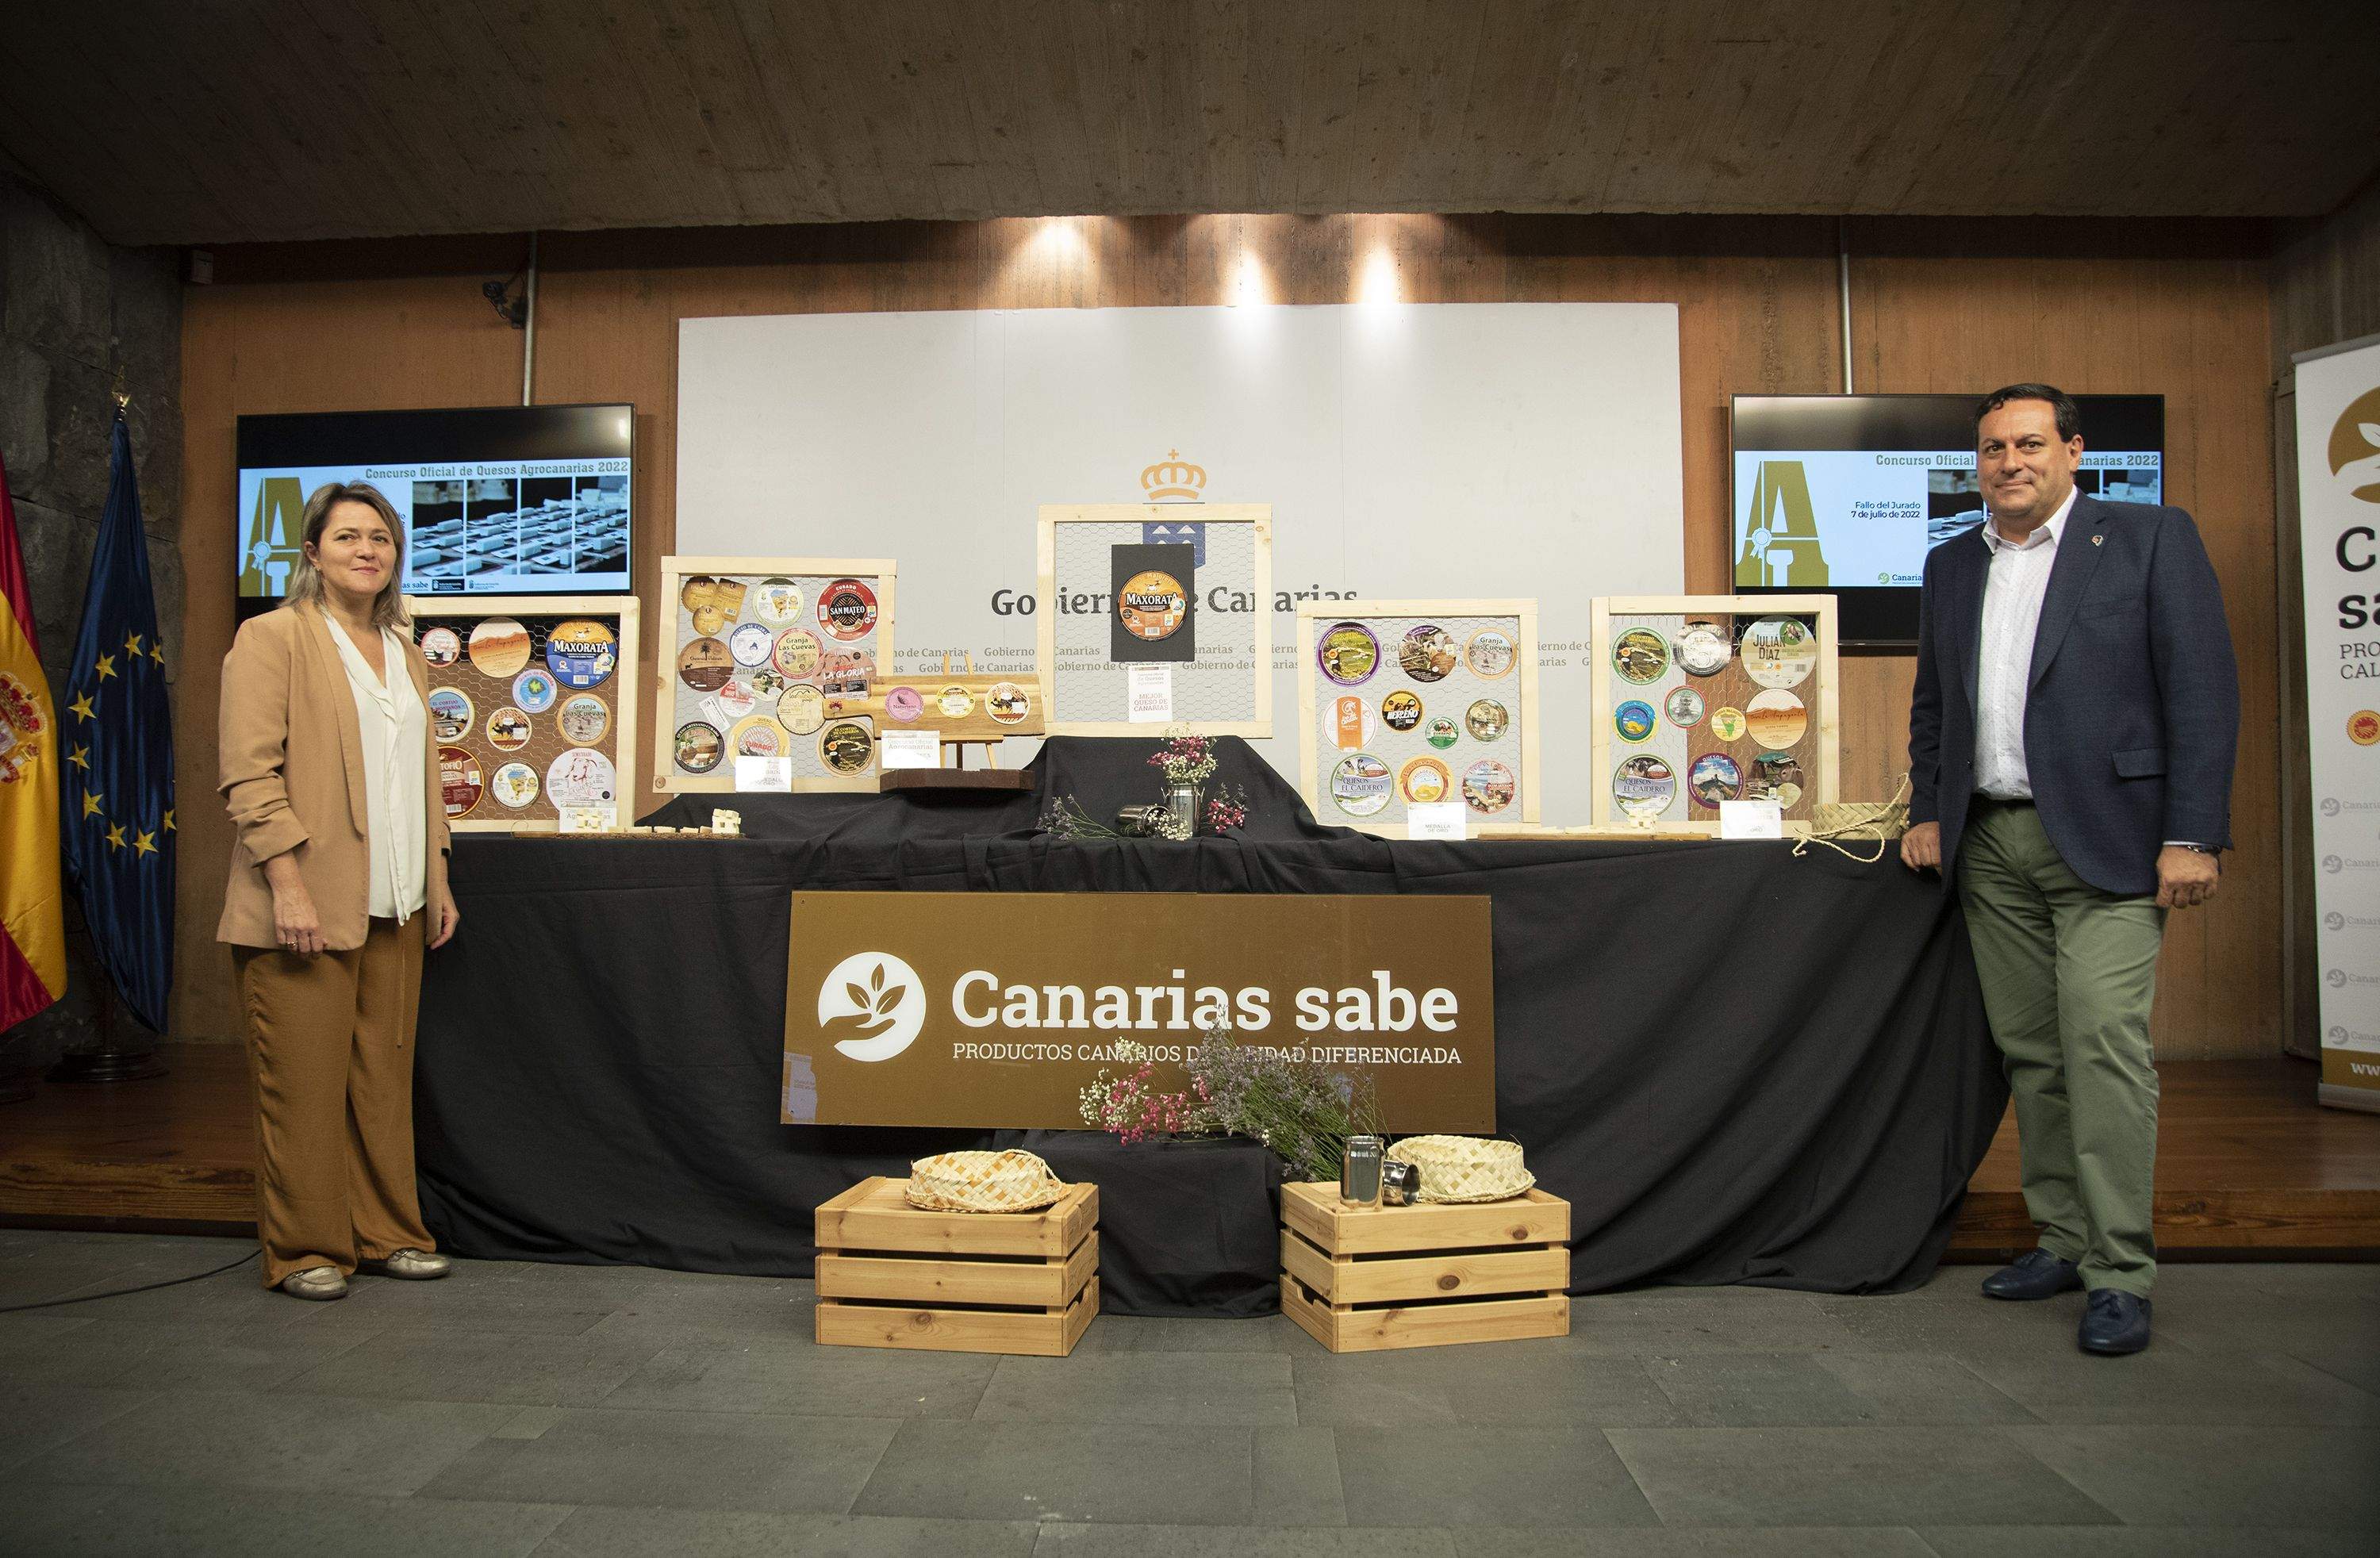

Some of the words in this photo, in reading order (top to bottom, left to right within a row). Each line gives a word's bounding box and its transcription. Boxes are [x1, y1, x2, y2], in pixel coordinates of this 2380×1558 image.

[1876, 455, 1931, 466] Concurso
[1936, 455, 1975, 466] Oficial
[2127, 455, 2158, 466] 2022
[365, 468, 416, 479] Concurso
[420, 466, 455, 477] Oficial
[459, 466, 473, 476] de
[477, 465, 516, 475] Quesos
[520, 462, 594, 476] Agrocanarias
[598, 462, 628, 472] 2022
[1870, 510, 1887, 520] julio
[830, 607, 843, 616] SAN
[554, 640, 609, 653] MAXORATA
[1569, 641, 1582, 650] de
[907, 648, 919, 658] de
[922, 648, 969, 658] Canarias
[985, 647, 1035, 657] Gobierno
[973, 662, 985, 672] de
[987, 662, 1035, 672] Canarias
[1103, 661, 1115, 671] de
[1182, 660, 1234, 670] Gobierno
[1236, 660, 1250, 670] de
[836, 668, 865, 678] GLORIA
[952, 969, 1272, 1031] Canarias
[1296, 969, 1460, 1032] sabe
[953, 1042, 1072, 1061] PRODUCTOS
[1311, 1046, 1462, 1064] DIFERENCIADA
